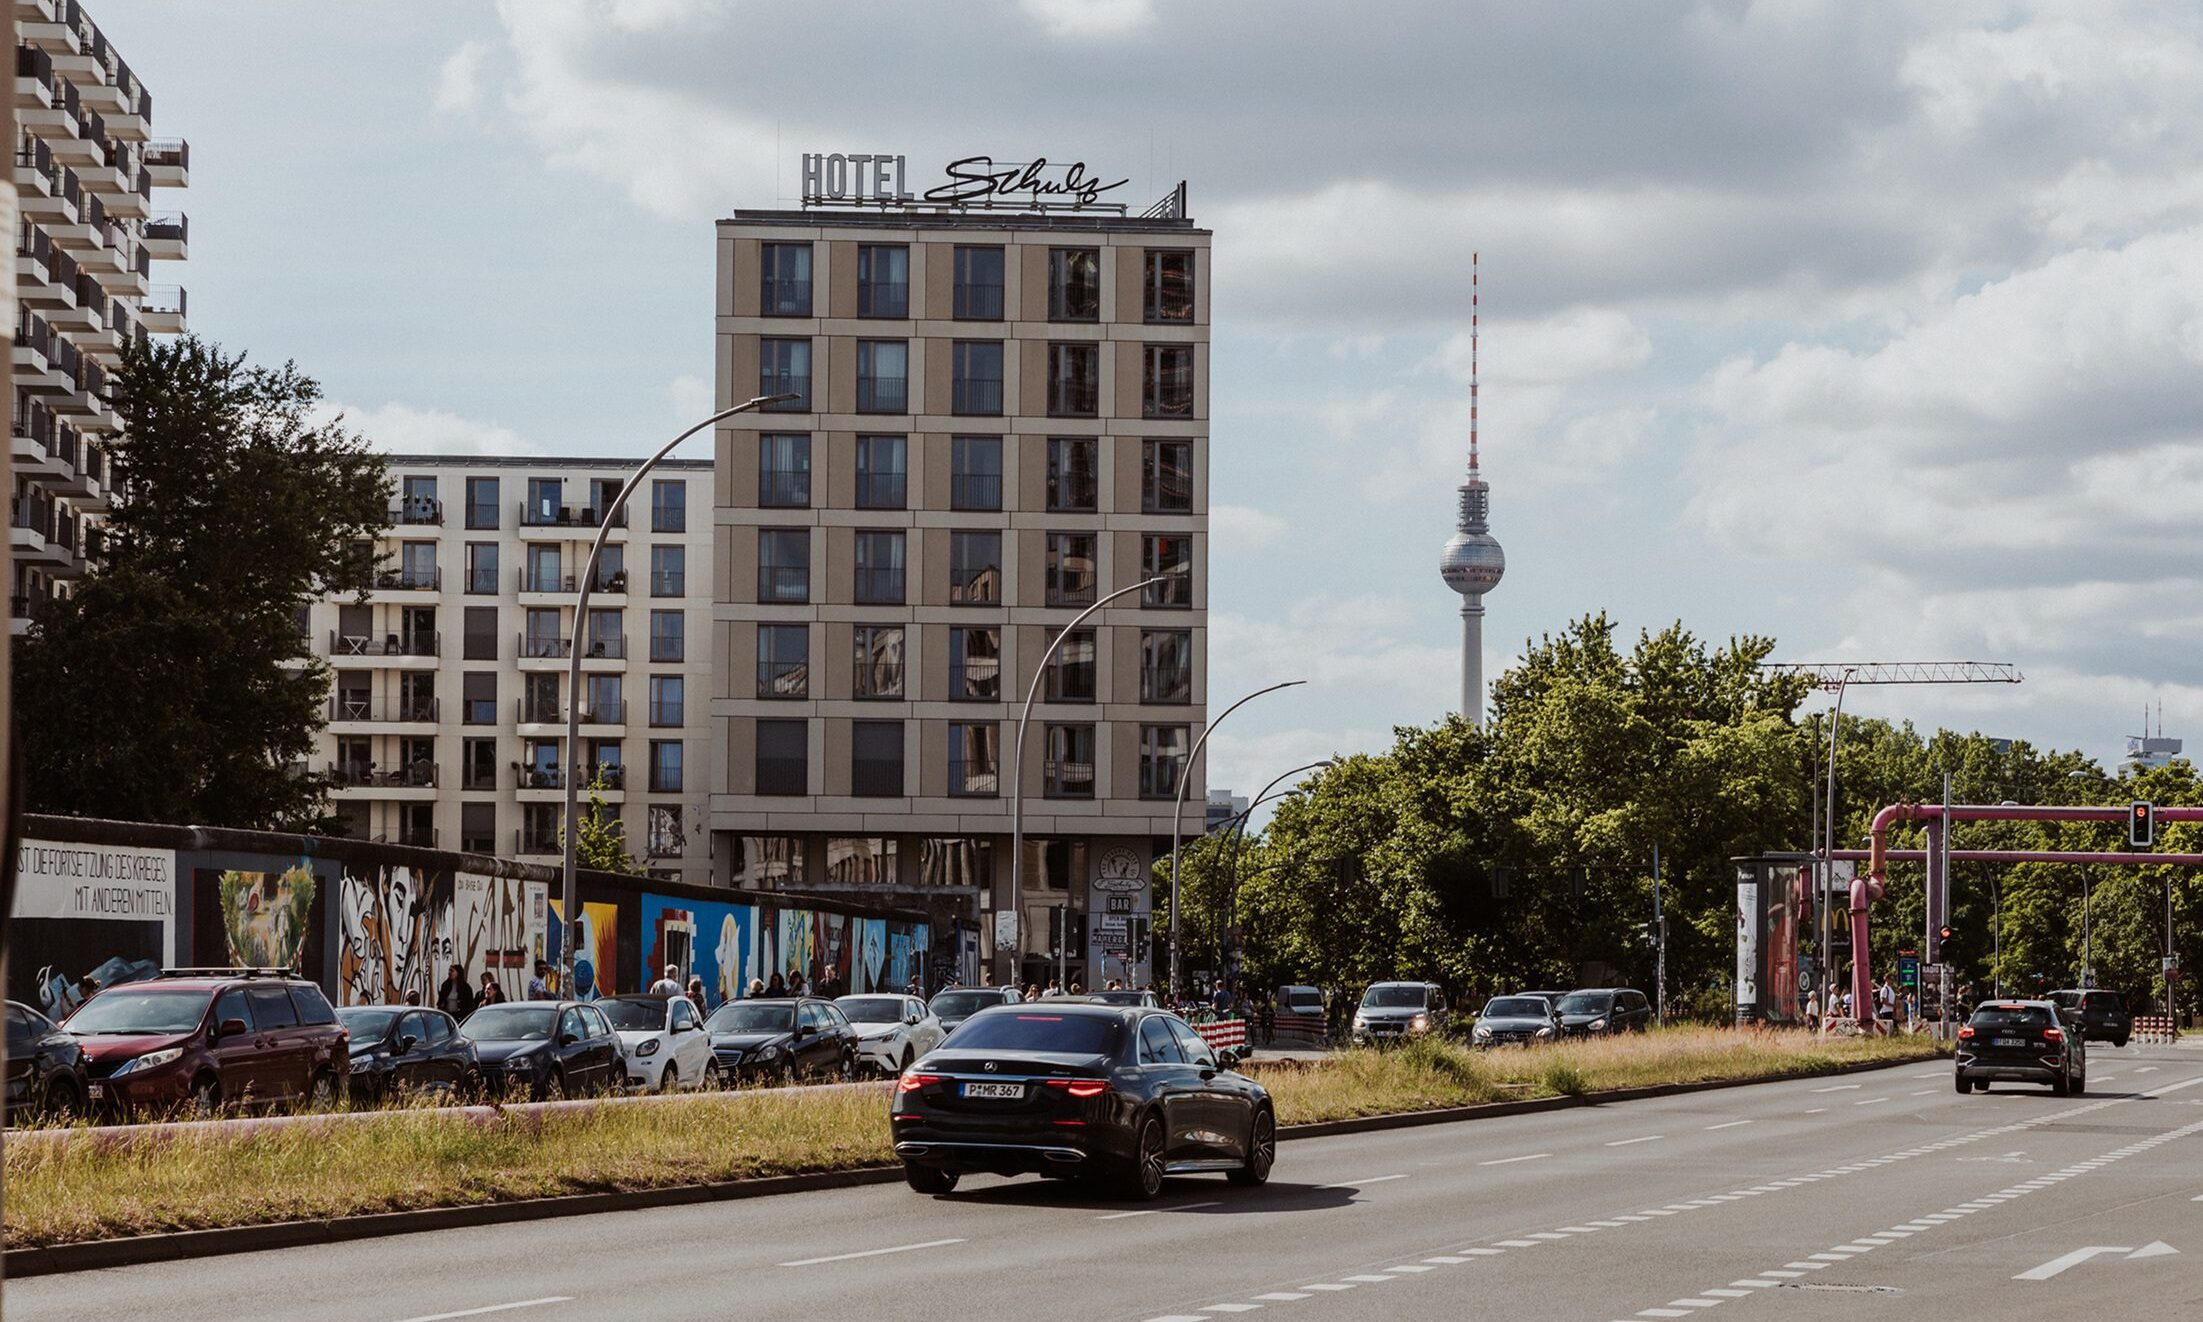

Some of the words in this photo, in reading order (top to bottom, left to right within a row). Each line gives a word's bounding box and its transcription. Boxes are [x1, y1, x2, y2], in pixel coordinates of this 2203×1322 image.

[802, 153, 915, 200] HOTEL
[924, 156, 1129, 203] Schulz
[49, 849, 113, 880] FORTSETZUNG
[115, 854, 132, 881] DES
[92, 887, 135, 914] ANDEREN
[1110, 898, 1130, 910] BAR
[969, 1084, 977, 1095] P
[983, 1085, 998, 1096] MR
[1000, 1086, 1020, 1097] 367
